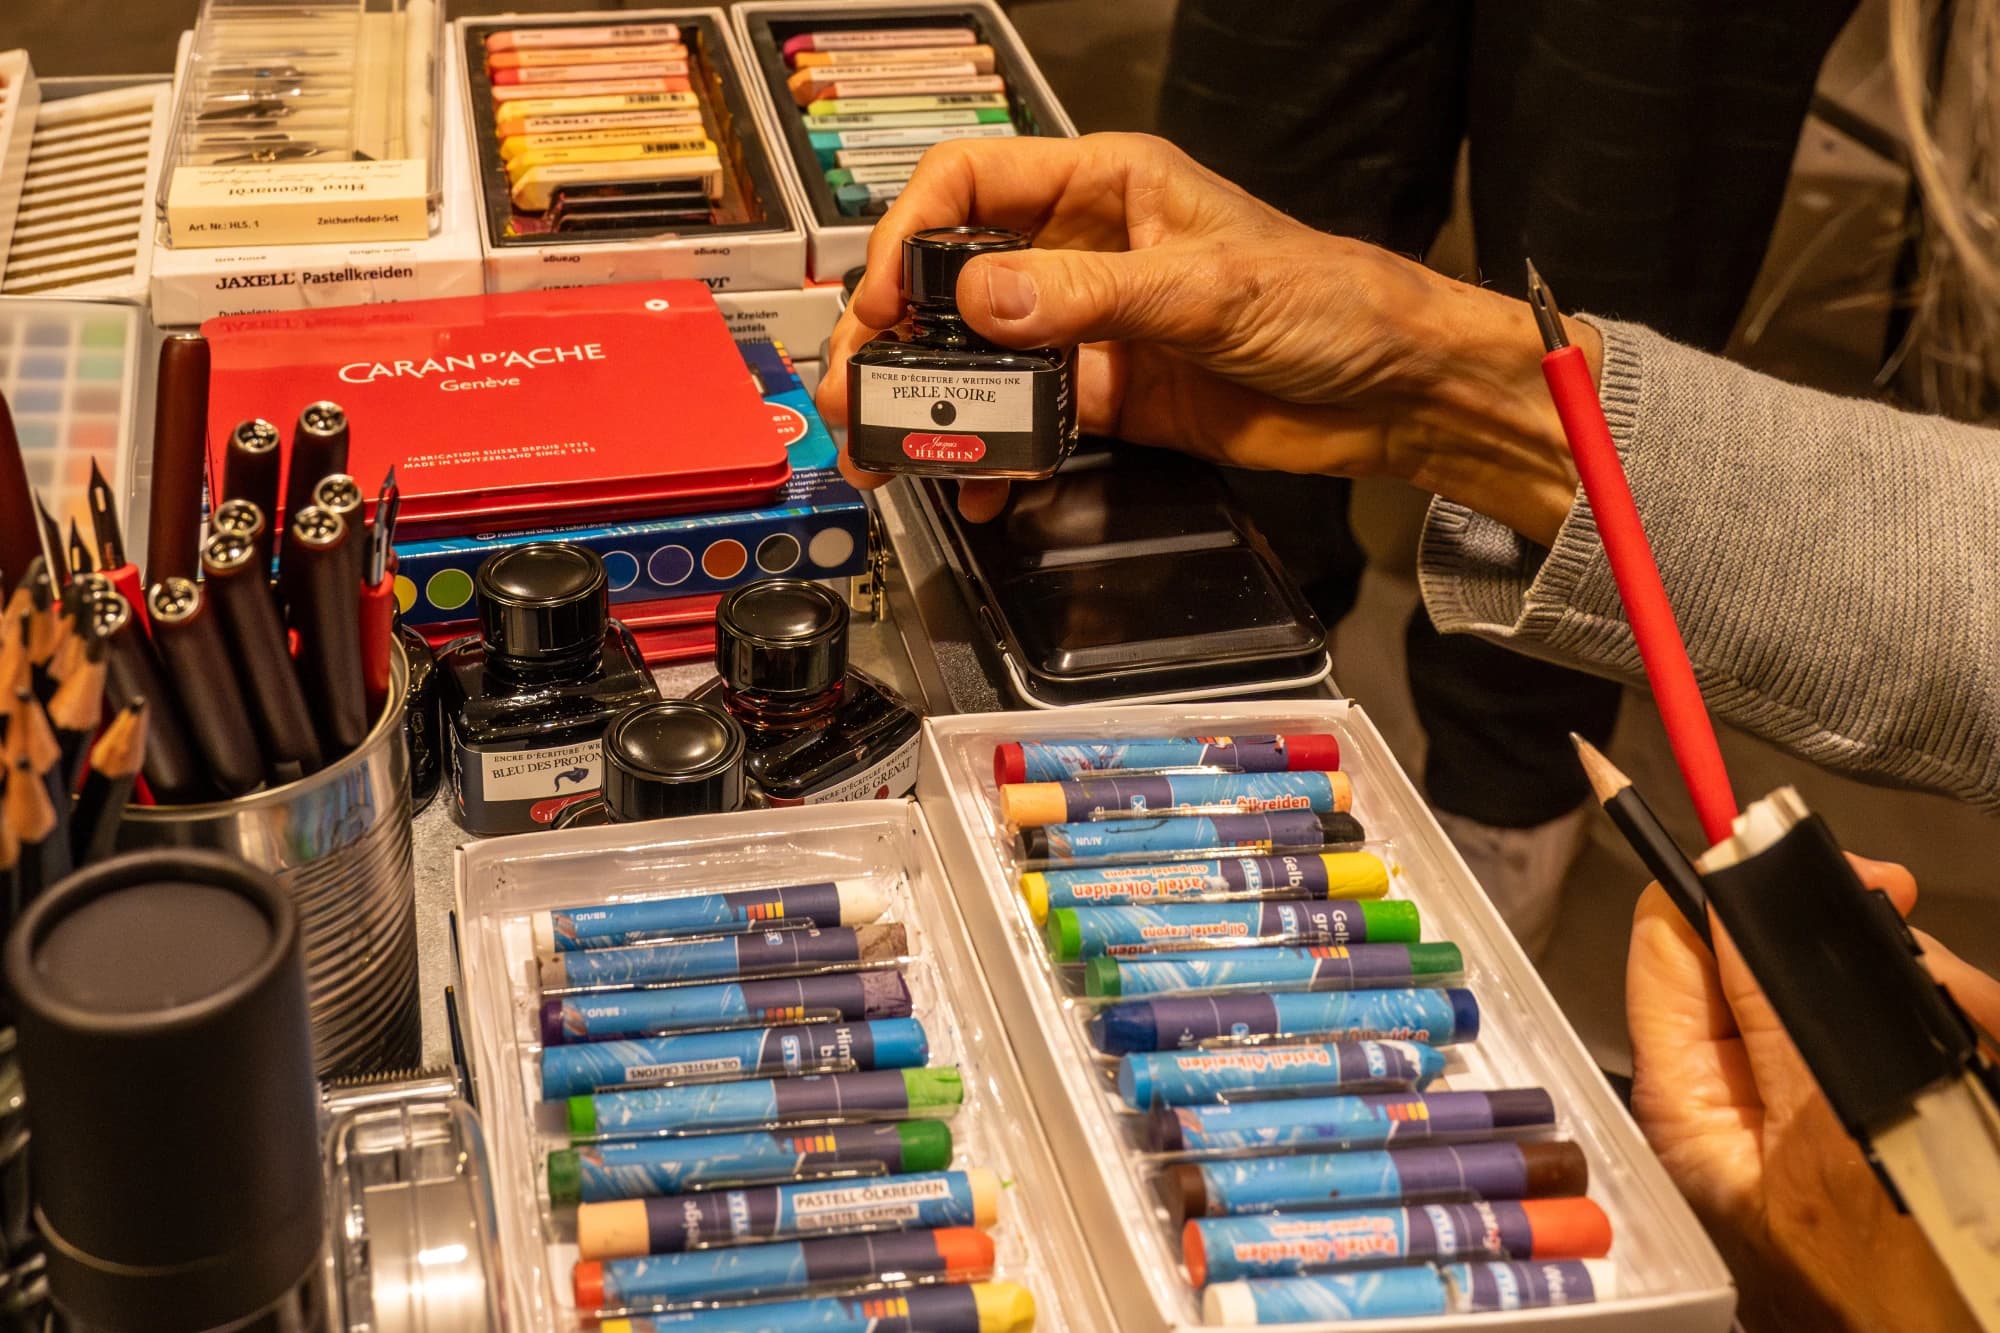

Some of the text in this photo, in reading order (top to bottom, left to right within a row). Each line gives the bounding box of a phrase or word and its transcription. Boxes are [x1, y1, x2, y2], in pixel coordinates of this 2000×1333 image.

[188, 222, 208, 232] Art.
[317, 213, 399, 226] Zeichenfeder-Set
[543, 254, 581, 264] Orange
[694, 247, 731, 257] Orange
[215, 265, 413, 290] JAXELL Pastellkreiden
[736, 310, 779, 320] Kreiden
[338, 343, 606, 383] CARAN D'ACHE
[439, 376, 521, 392] Genève
[871, 372, 899, 381] ENCRE
[901, 374, 953, 384] D'ÉCRITURE
[962, 377, 1002, 385] WRITING
[1004, 377, 1021, 385] INK
[892, 386, 997, 403] PERLE NOIRE
[403, 446, 596, 469] MADE IN SWITZERLAND SINCE 1915
[407, 441, 589, 463] FABRICATION SUISSE DEPUIS 1915
[915, 445, 974, 461] HERBIN
[494, 754, 523, 763] ENCRE
[526, 747, 580, 760] D'ÉCRITURE
[492, 765, 525, 779] BLEU
[527, 760, 552, 773] DES
[872, 756, 913, 789] GRENAT
[1103, 864, 1209, 878] Oil pastel crayons
[1282, 856, 1303, 888] Gelb
[1141, 921, 1248, 938] Oil pastel crayons
[630, 1059, 739, 1081] OIL PASTEL CRAYONS
[796, 1182, 946, 1206] PASTELL-ÖLKREIDEN
